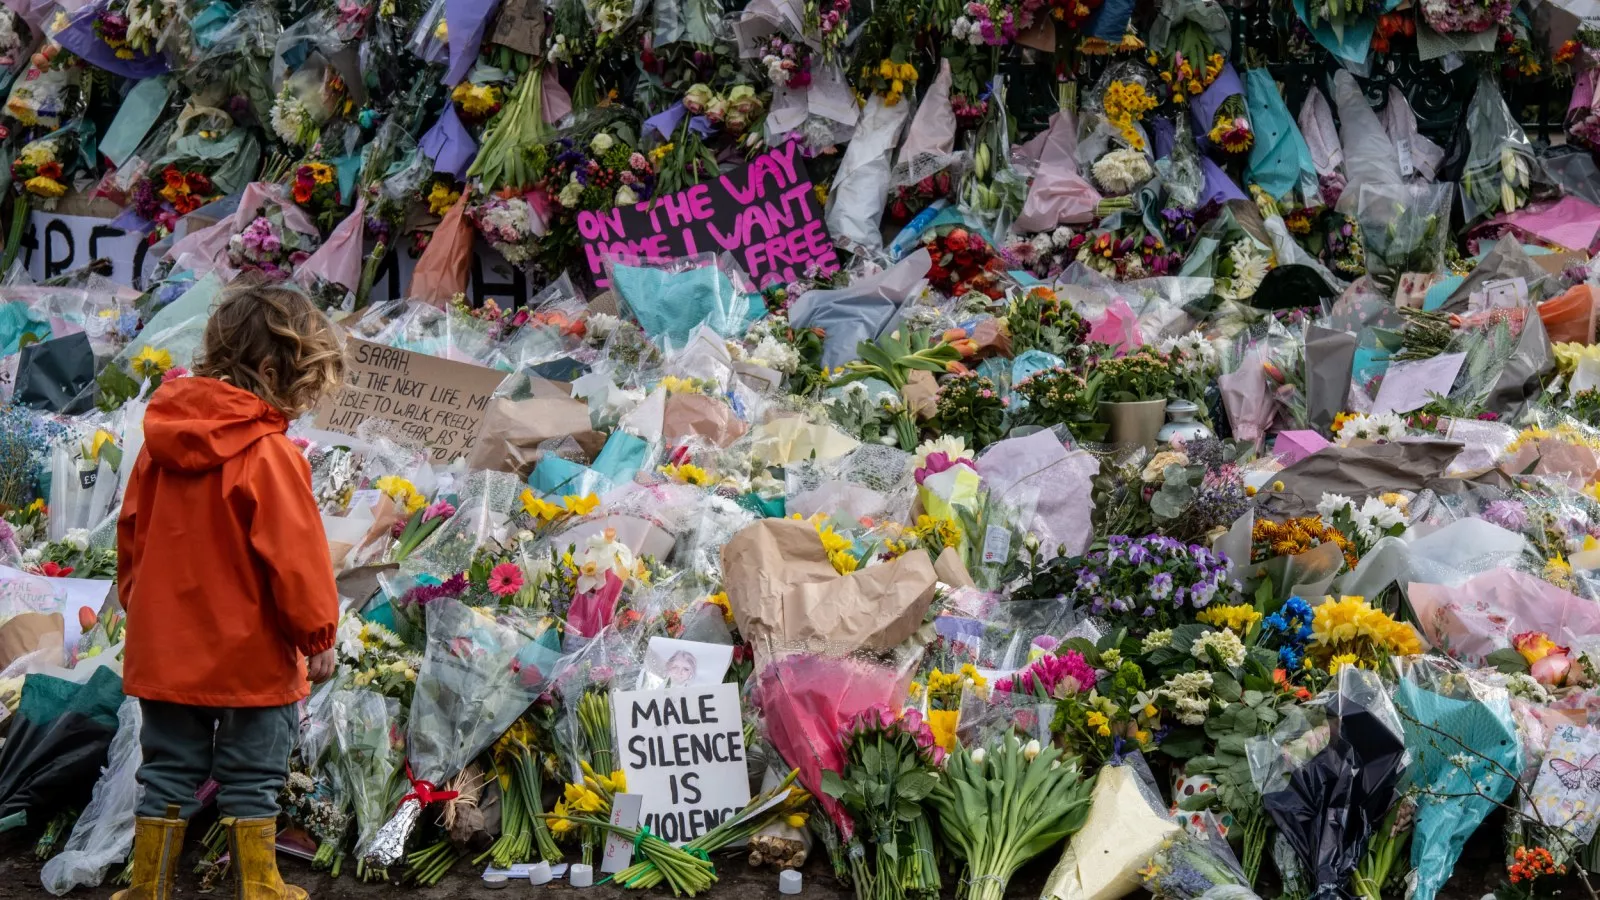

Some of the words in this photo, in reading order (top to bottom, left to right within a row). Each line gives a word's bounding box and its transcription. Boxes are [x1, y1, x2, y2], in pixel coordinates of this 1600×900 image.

[577, 207, 626, 242] ON
[635, 184, 716, 233] THE
[719, 140, 798, 204] WAY
[584, 233, 673, 274] HOME
[682, 228, 699, 260] I
[706, 181, 813, 250] WANT
[355, 344, 410, 375] SARAH,
[367, 371, 392, 392] THE
[392, 377, 428, 400] NEXT
[430, 385, 461, 410] LIFE,
[374, 395, 392, 414] TO
[394, 401, 433, 423] WALK
[432, 410, 479, 434] FREELY,
[401, 422, 433, 442] FEAR
[434, 429, 458, 446] AS
[432, 447, 448, 460] TO
[631, 694, 719, 729] MALE
[628, 731, 743, 770] SILENCE
[669, 772, 702, 805] IS
